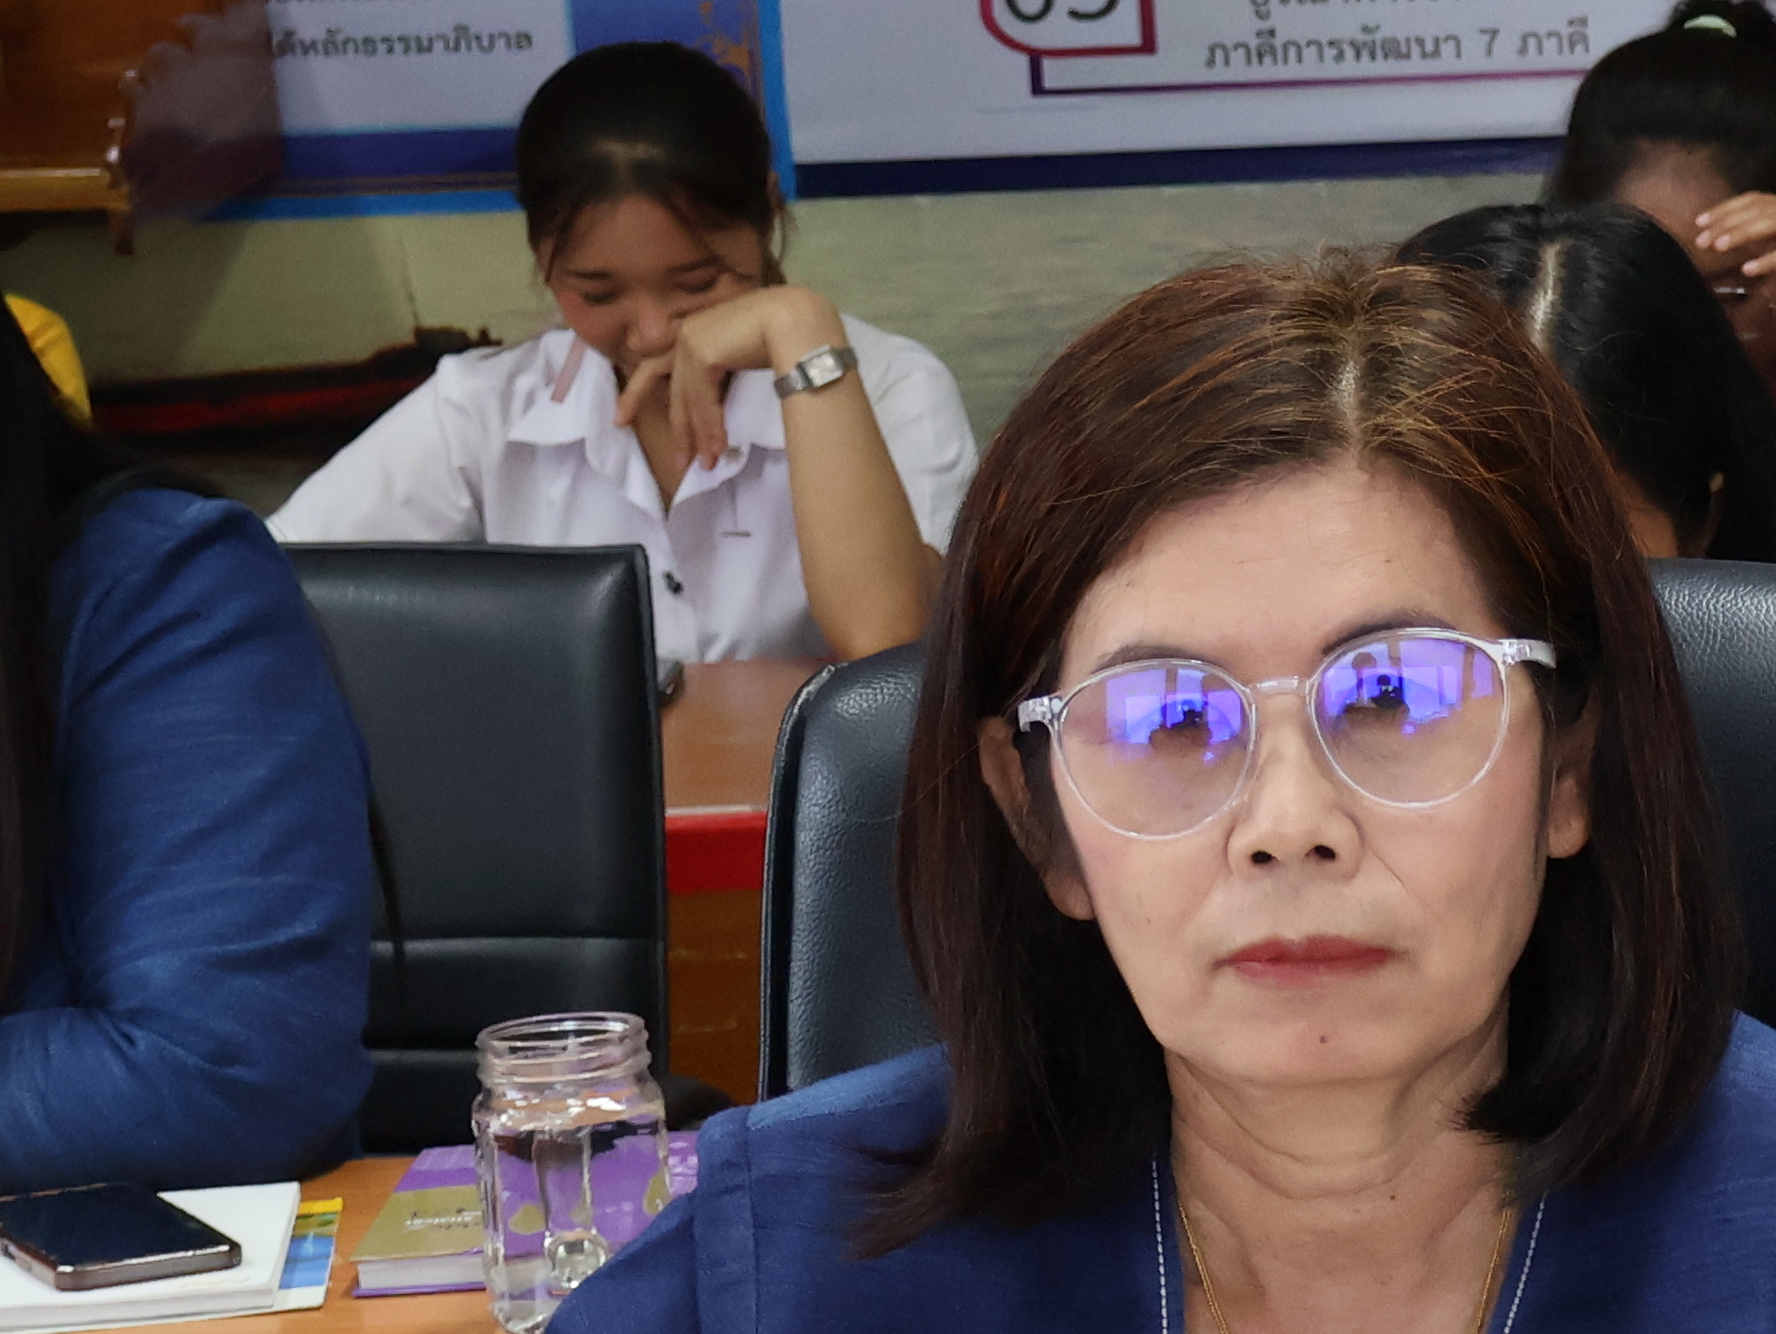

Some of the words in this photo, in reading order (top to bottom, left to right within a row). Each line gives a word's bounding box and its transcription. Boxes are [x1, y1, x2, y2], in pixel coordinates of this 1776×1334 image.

[1203, 23, 1464, 69] ภาคีการพัฒนา
[1479, 28, 1502, 60] 7
[1516, 19, 1592, 58] ภาคี
